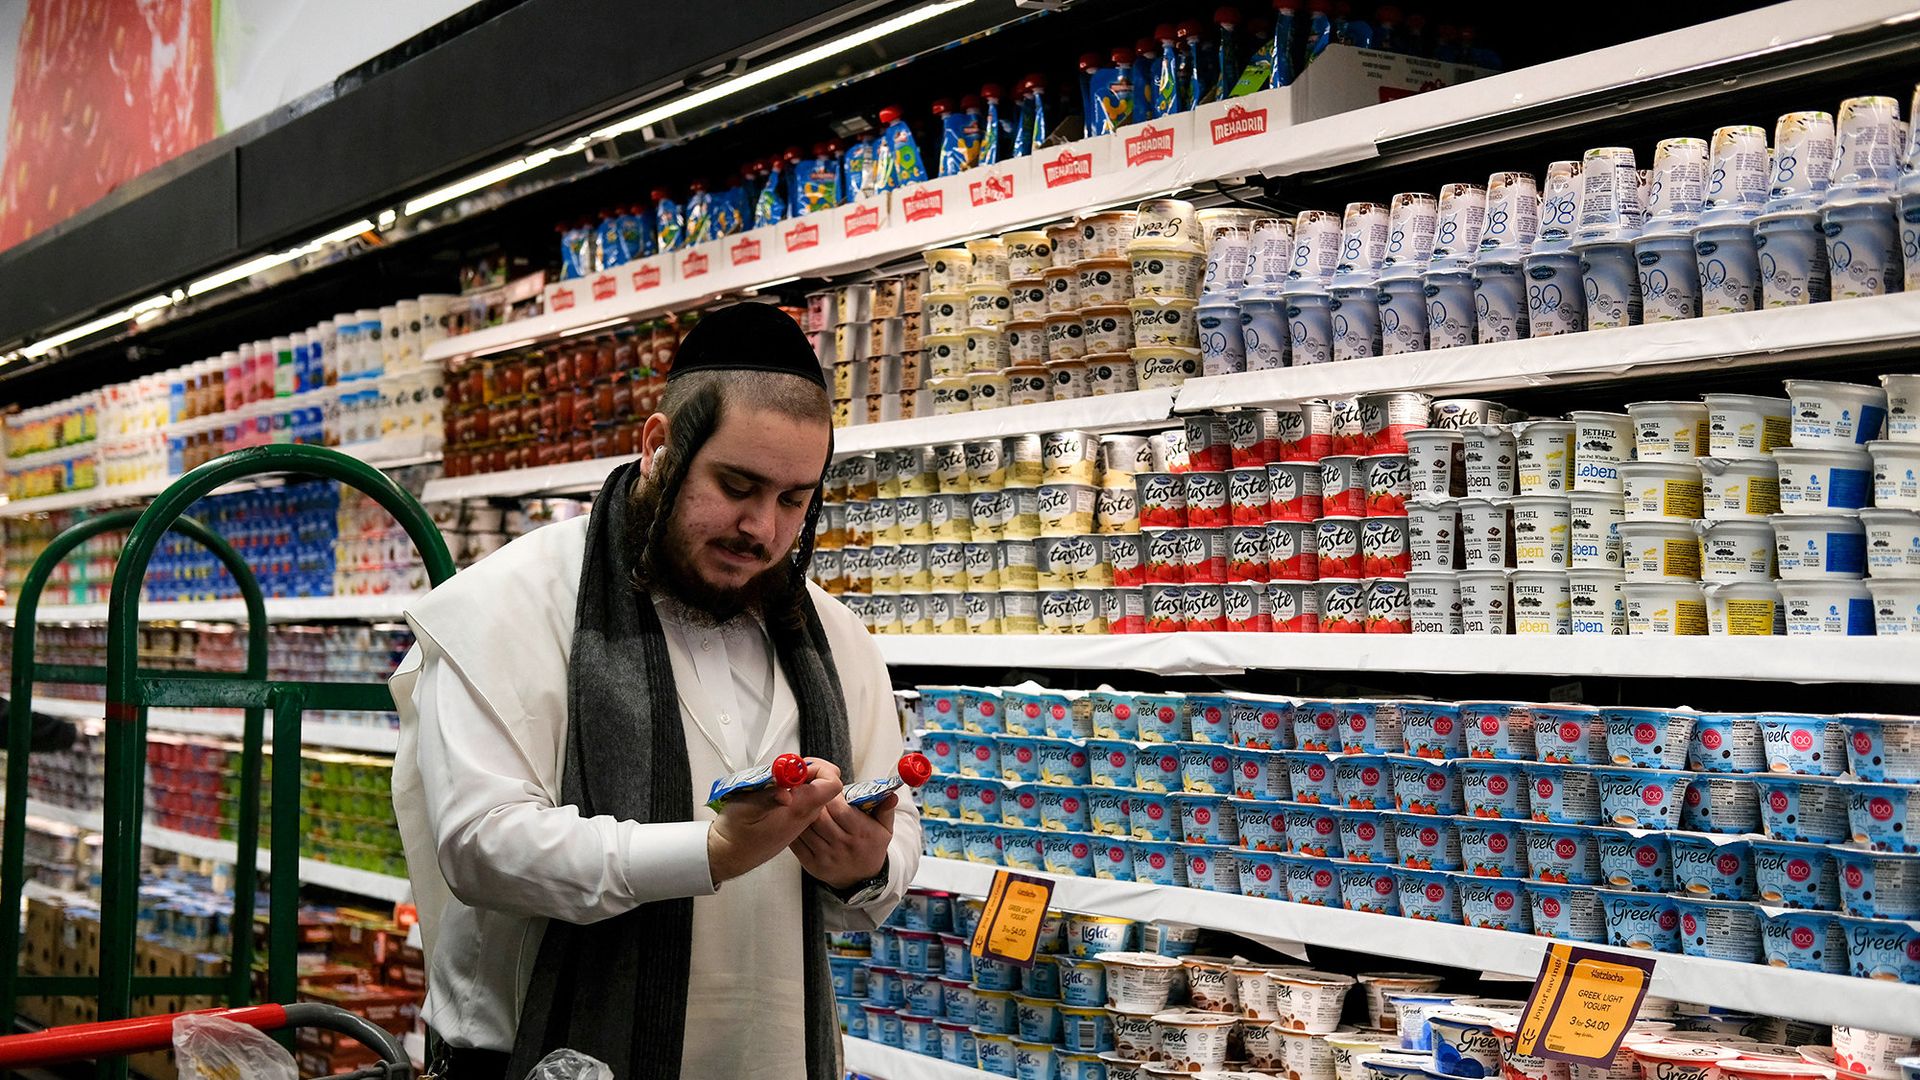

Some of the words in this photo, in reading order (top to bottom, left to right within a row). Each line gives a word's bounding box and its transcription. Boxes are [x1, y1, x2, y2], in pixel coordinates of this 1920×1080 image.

[1215, 115, 1264, 141] MEHADRIN
[1128, 133, 1171, 153] MEHADRIN
[1853, 267, 1863, 275] 0%
[1529, 284, 1562, 310] 80
[1143, 358, 1182, 379] Greek
[1438, 409, 1478, 429] taste
[1583, 429, 1616, 438] BETHEL
[1808, 426, 1831, 434] Yogurt
[1044, 439, 1079, 458] taste
[1371, 464, 1410, 488] tast
[1577, 464, 1617, 479] Leben
[1146, 482, 1185, 502] taste
[1188, 480, 1223, 502] taste
[1232, 477, 1268, 500] taste
[973, 501, 1002, 518] tast
[1318, 528, 1354, 551] taste
[1364, 526, 1400, 550] taste
[1151, 540, 1181, 558] tast
[1234, 536, 1268, 556] tast
[932, 551, 963, 568] taste
[1184, 592, 1218, 612] taste
[1327, 594, 1363, 613] tast
[1044, 599, 1071, 616] tast
[1159, 711, 1174, 719] 100
[1264, 717, 1278, 725] 100
[1319, 717, 1333, 725] 100
[1351, 718, 1364, 727] 100
[1436, 721, 1451, 730] 100
[1482, 721, 1497, 730] 100
[1410, 728, 1432, 737] LIGHT
[1561, 728, 1578, 737] 100
[1638, 729, 1654, 738] 100
[1611, 736, 1633, 746] LIGHT
[1703, 735, 1720, 744] 100
[1793, 736, 1810, 745] 100
[1163, 760, 1176, 768] 100
[1214, 760, 1228, 768] 100
[1244, 766, 1258, 775] 100
[1310, 769, 1324, 777] 100
[1363, 772, 1378, 781] 100
[1429, 778, 1444, 786] 100
[1490, 781, 1506, 790] 100
[1402, 783, 1424, 793] LIGHT
[1538, 784, 1552, 793] 100
[1601, 774, 1642, 802] Greek
[1645, 790, 1662, 799] 100
[1612, 797, 1640, 807] LIGHT
[1772, 797, 1786, 807] 100
[1872, 804, 1890, 815] 100
[1197, 812, 1209, 820] 100
[1238, 807, 1271, 829] Greek
[1318, 822, 1332, 830] 100
[1360, 827, 1373, 836] 100
[1422, 833, 1436, 841] 100
[1490, 839, 1505, 847] 100
[1559, 844, 1575, 853] 100
[1533, 851, 1555, 861] LIGHT
[1639, 852, 1656, 860] 100
[1674, 841, 1718, 868] Greek
[1720, 859, 1737, 869] 100
[1609, 858, 1634, 868] LIGHT
[1257, 869, 1270, 877] 100
[1686, 865, 1715, 876] LIGHT
[1789, 866, 1808, 875] 100
[1316, 875, 1330, 883] 100
[1341, 869, 1375, 892] Greek
[1377, 881, 1391, 890] 100
[1350, 888, 1372, 897] LIGHT
[1427, 888, 1443, 897] 100
[1497, 896, 1512, 905] 100
[1469, 903, 1492, 912] LIGHT
[1544, 903, 1559, 912] 100
[1611, 899, 1660, 926] Greek
[1661, 915, 1678, 925] 100
[1627, 922, 1656, 933] LIGHT
[1082, 926, 1108, 944] Light
[1794, 933, 1812, 943] 100
[1853, 926, 1908, 955] Greek
[1191, 965, 1228, 988] Greek
[1578, 990, 1601, 999] GREEK
[1603, 993, 1623, 1003] LIGHT
[1584, 1001, 1611, 1012] YOGURT
[1533, 1006, 1544, 1020] joy
[1116, 1014, 1152, 1036] Greek
[1570, 1017, 1576, 1025] 3
[1584, 1019, 1609, 1031] $4.00
[1457, 1028, 1500, 1053] Gree
